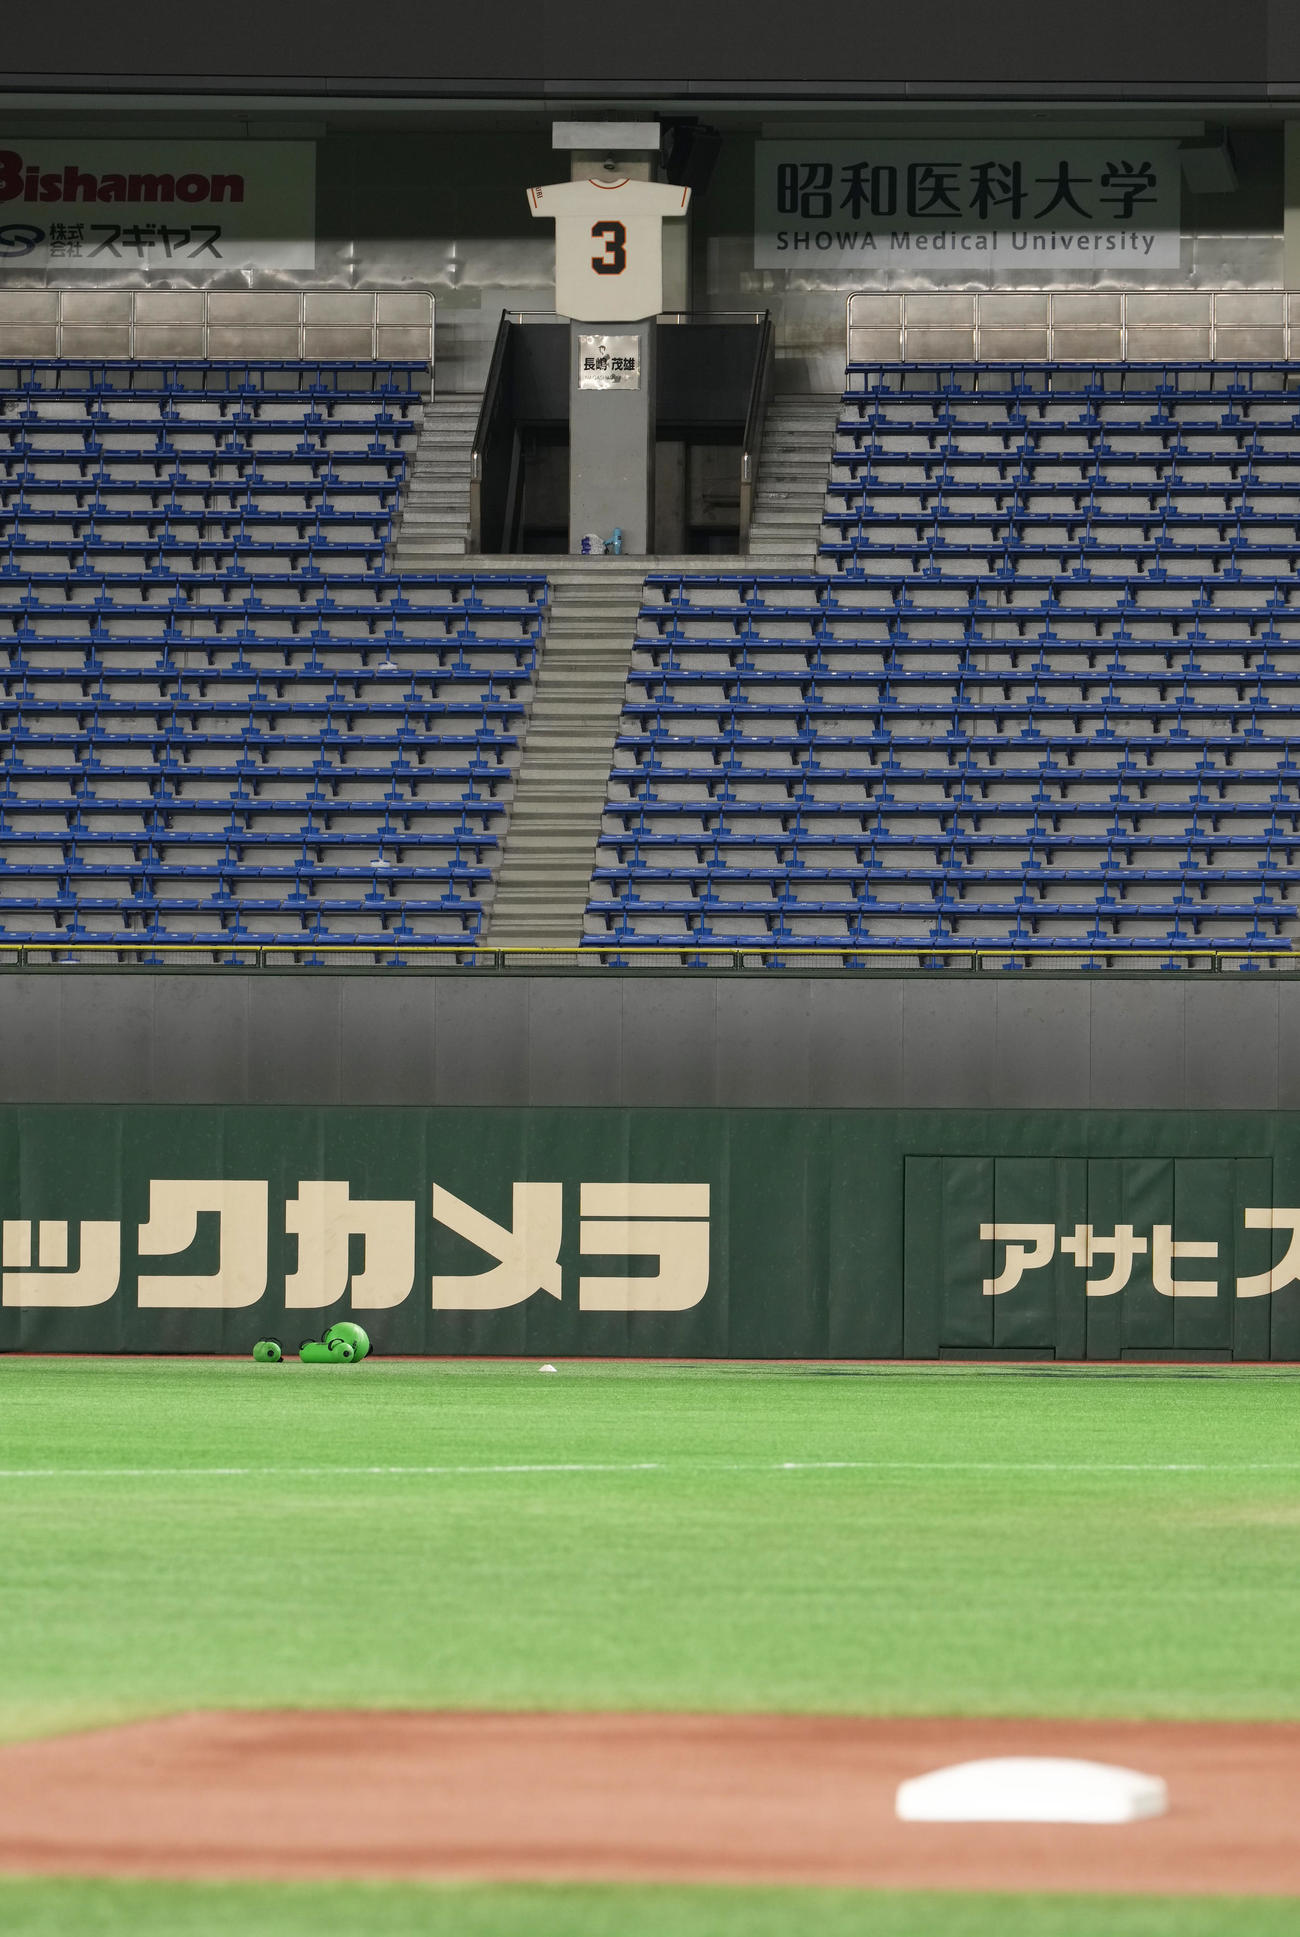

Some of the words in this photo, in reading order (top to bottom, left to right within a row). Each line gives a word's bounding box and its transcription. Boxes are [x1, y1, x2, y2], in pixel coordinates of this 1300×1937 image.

[776, 160, 1158, 220] 昭和医科大学
[591, 220, 626, 275] 3
[777, 231, 877, 250] SHOWA
[890, 230, 998, 250] Medical
[1012, 230, 1155, 255] University
